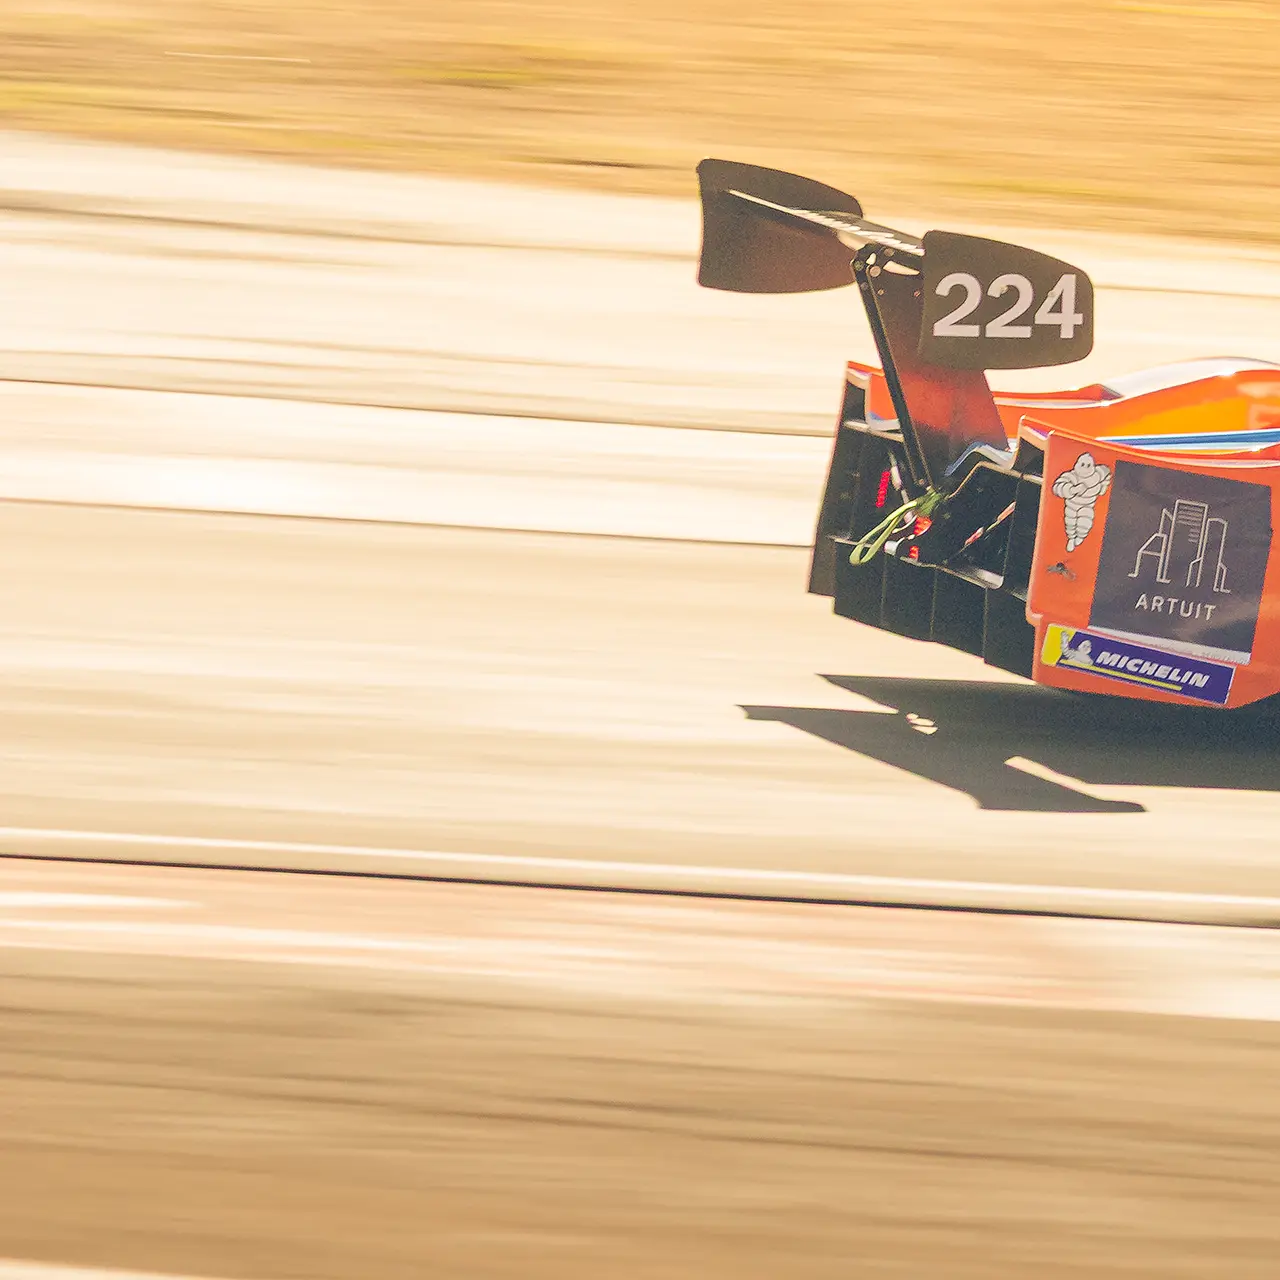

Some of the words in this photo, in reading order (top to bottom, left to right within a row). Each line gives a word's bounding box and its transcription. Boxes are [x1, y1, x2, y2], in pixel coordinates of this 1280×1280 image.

[932, 272, 1084, 339] 224
[1134, 593, 1217, 621] ARTUIT
[1096, 651, 1211, 689] MICHELIN
